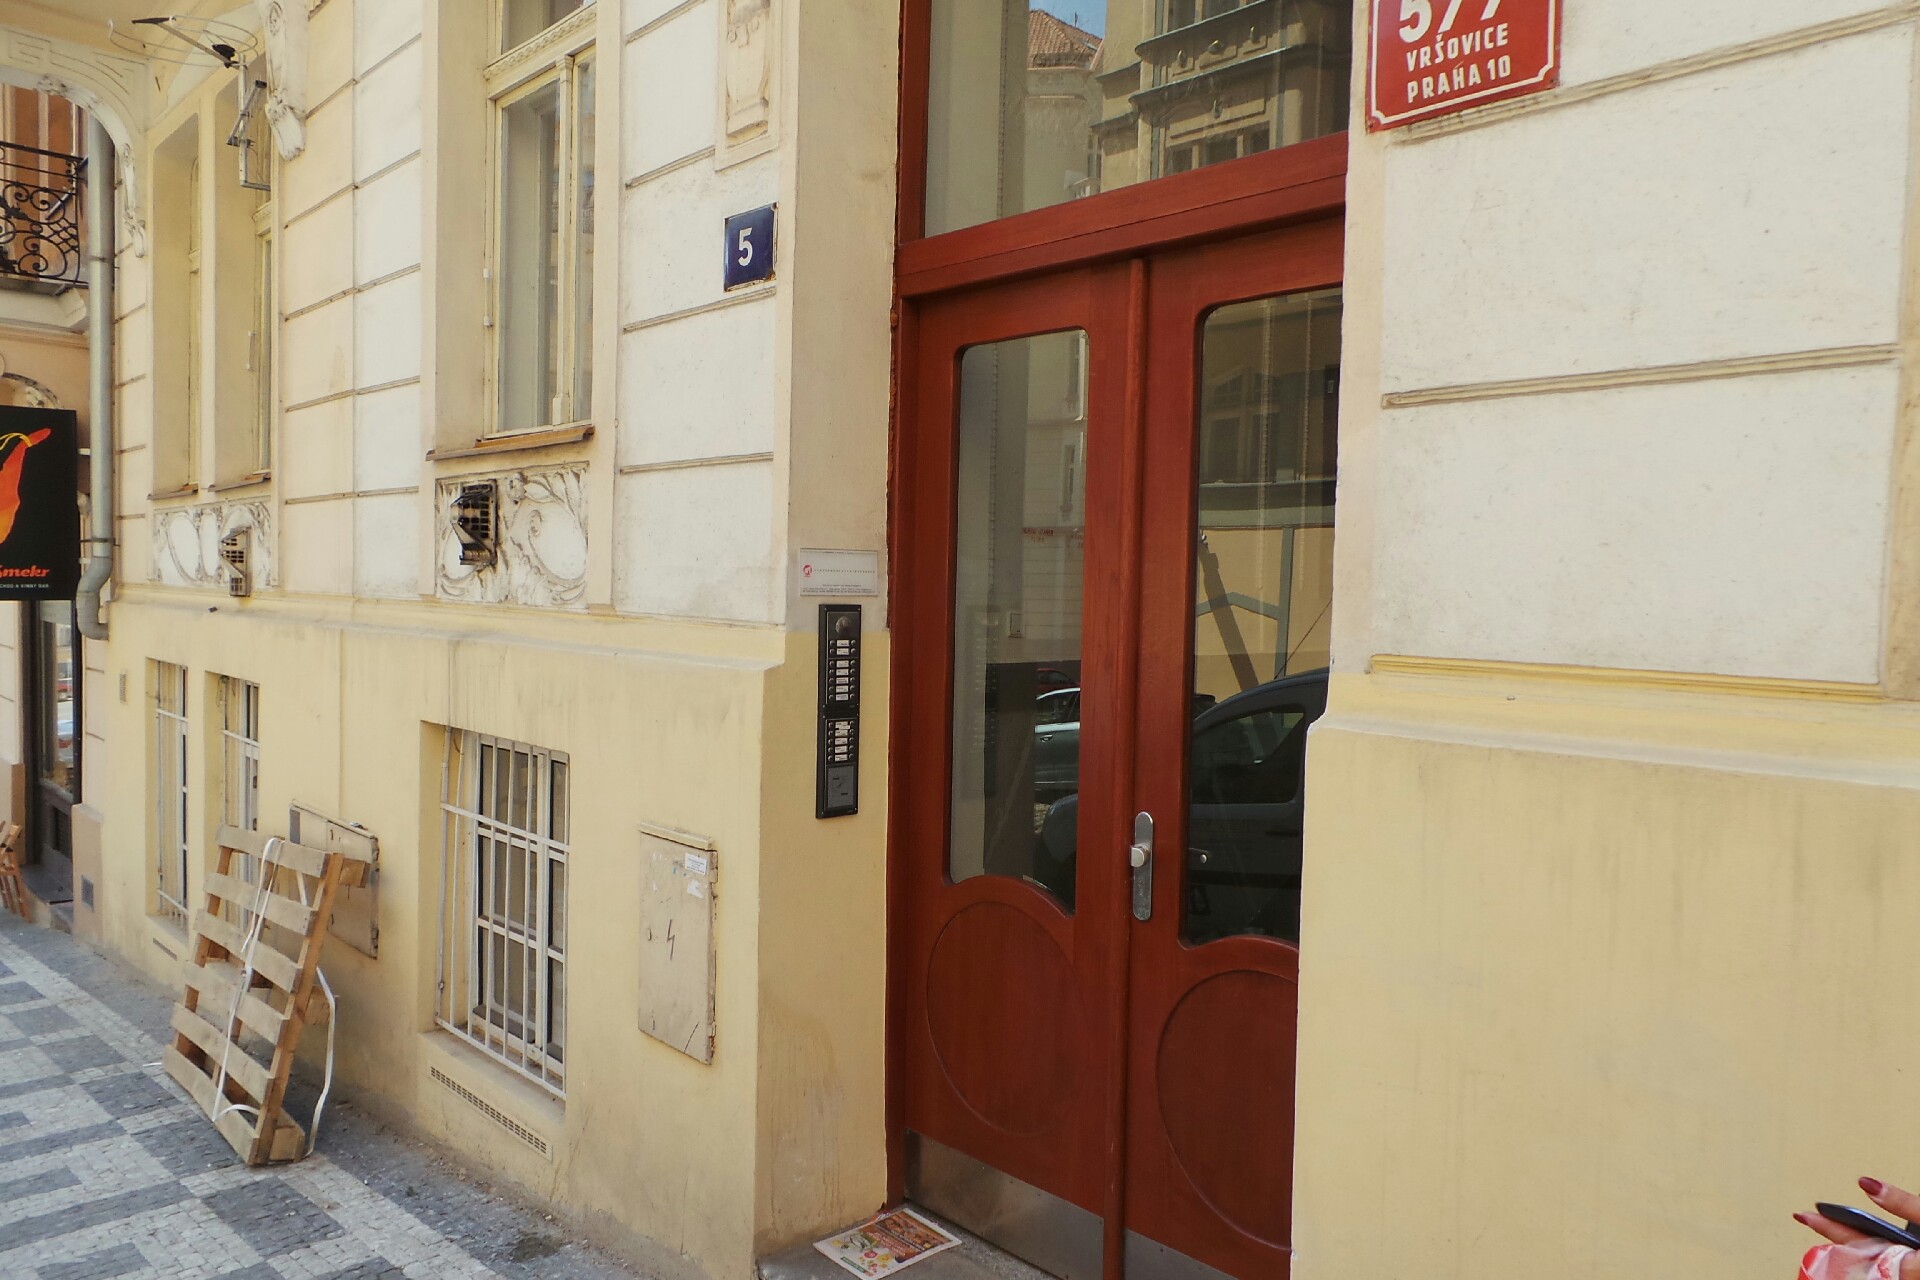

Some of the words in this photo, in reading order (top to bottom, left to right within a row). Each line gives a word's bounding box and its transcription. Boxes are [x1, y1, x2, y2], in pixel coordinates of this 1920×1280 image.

[1406, 22, 1509, 72] VRŠOVICE
[1407, 63, 1482, 104] PRAHA
[1487, 54, 1511, 81] 10
[738, 227, 753, 267] 5
